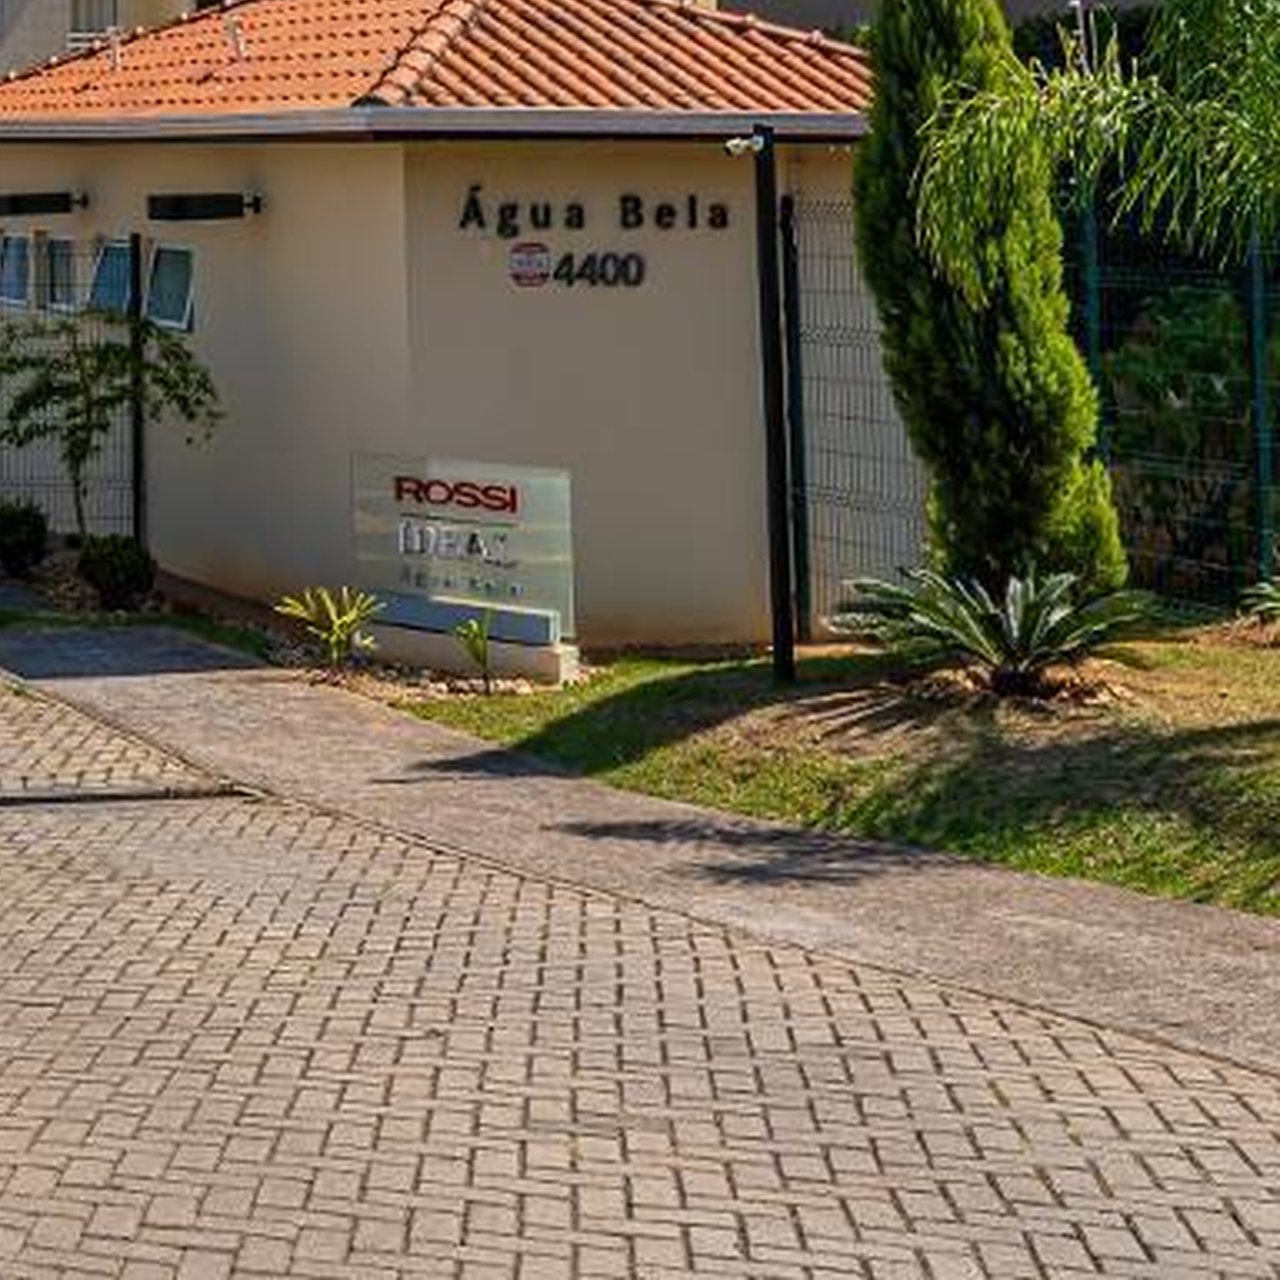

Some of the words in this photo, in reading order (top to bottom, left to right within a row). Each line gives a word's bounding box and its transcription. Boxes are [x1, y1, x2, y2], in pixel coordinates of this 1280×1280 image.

[459, 184, 585, 238] Água
[619, 194, 730, 229] Bela
[553, 253, 645, 287] 4400
[394, 477, 517, 513] ROSSI
